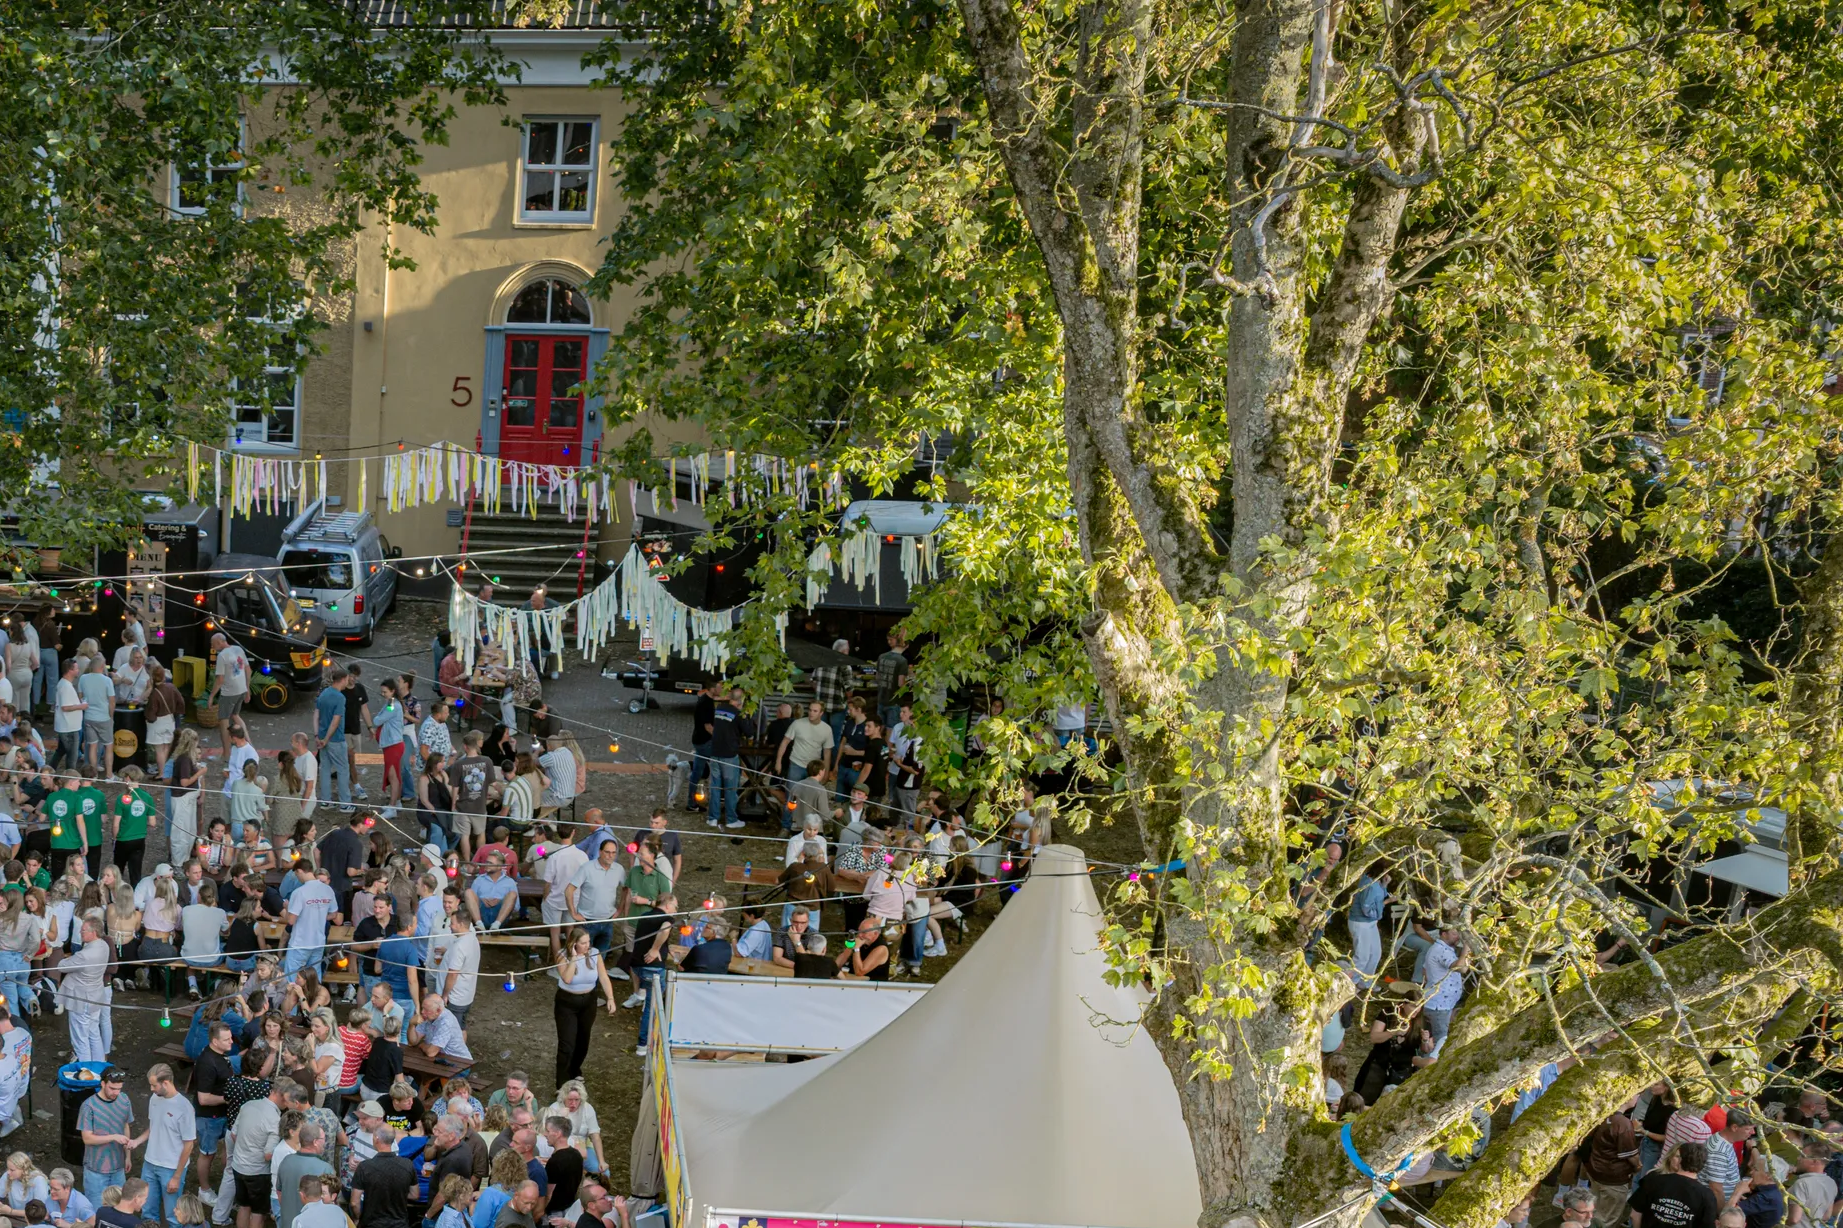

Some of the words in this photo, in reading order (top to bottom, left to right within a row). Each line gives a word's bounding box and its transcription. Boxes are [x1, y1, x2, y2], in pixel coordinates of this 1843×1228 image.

[451, 376, 473, 408] 5
[148, 523, 179, 533] Catering
[131, 553, 162, 562] MENU
[1651, 1203, 1695, 1221] REPRESENT
